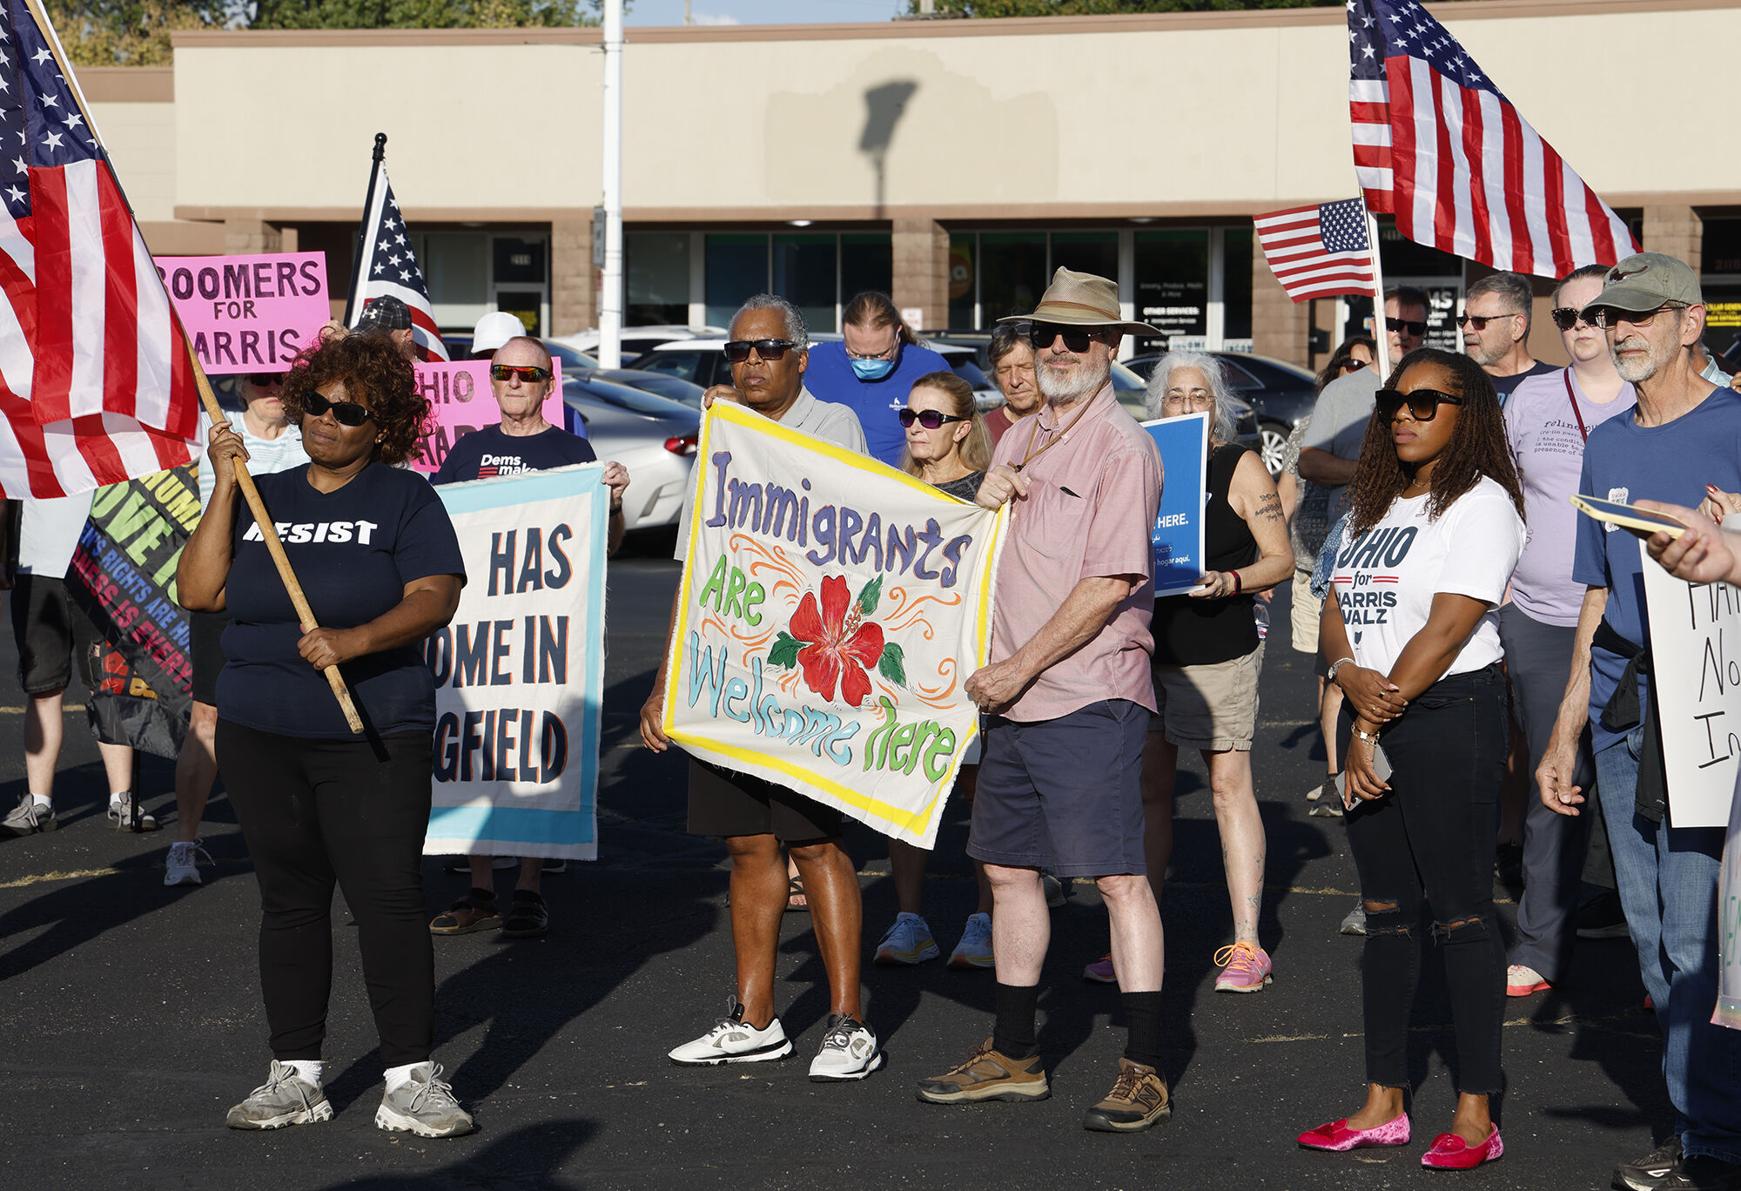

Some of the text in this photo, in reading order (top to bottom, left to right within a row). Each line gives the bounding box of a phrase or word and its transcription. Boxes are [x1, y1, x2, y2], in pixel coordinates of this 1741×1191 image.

[213, 300, 258, 320] FOR
[480, 453, 522, 467] Dems
[1157, 512, 1190, 529] HERE.
[100, 548, 153, 603] RIGHTS
[144, 597, 178, 629] ARE
[487, 523, 574, 597] HAS
[1352, 571, 1373, 590] for
[1338, 591, 1398, 608] ARRIS
[424, 614, 570, 690] OME IN
[688, 630, 861, 765] Welcome
[433, 707, 569, 785] GFIELD
[863, 694, 957, 784] here
